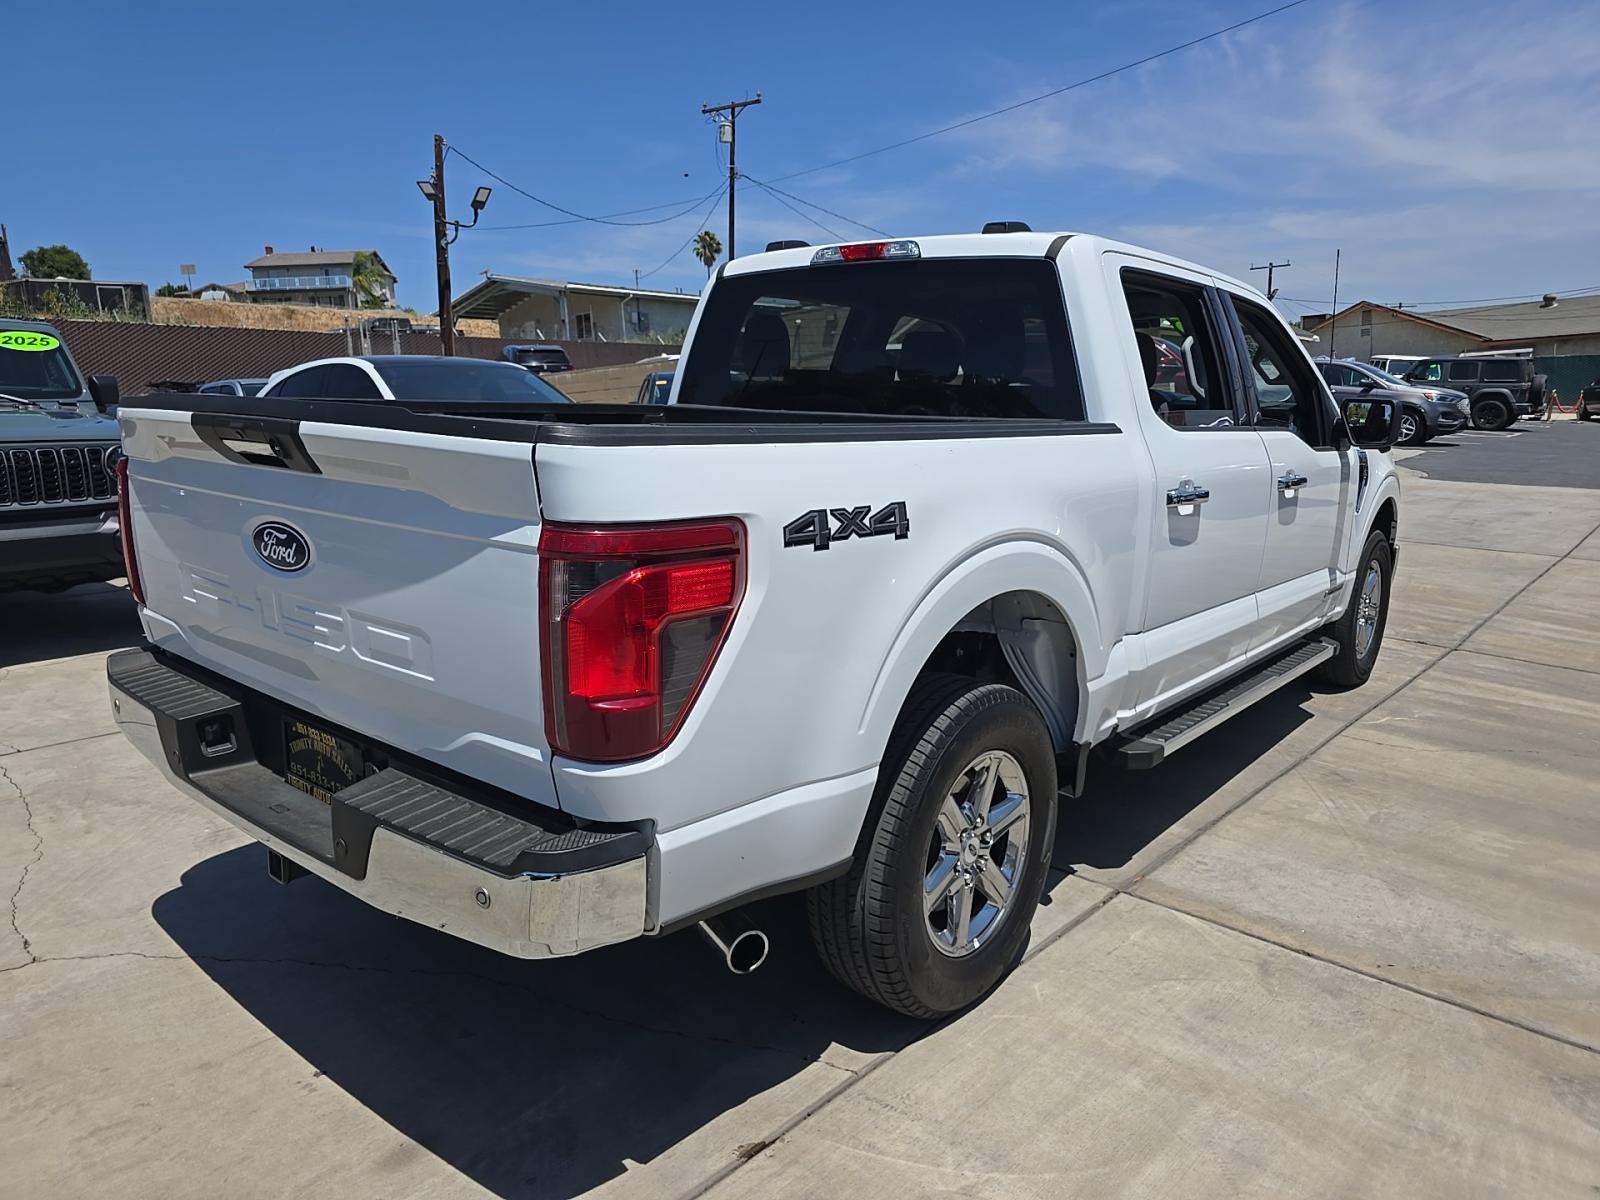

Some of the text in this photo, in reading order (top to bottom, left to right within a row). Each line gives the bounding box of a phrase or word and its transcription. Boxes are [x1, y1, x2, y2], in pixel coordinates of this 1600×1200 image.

[1, 335, 51, 347] 2025
[260, 528, 298, 564] Ford
[179, 562, 435, 682] F-150
